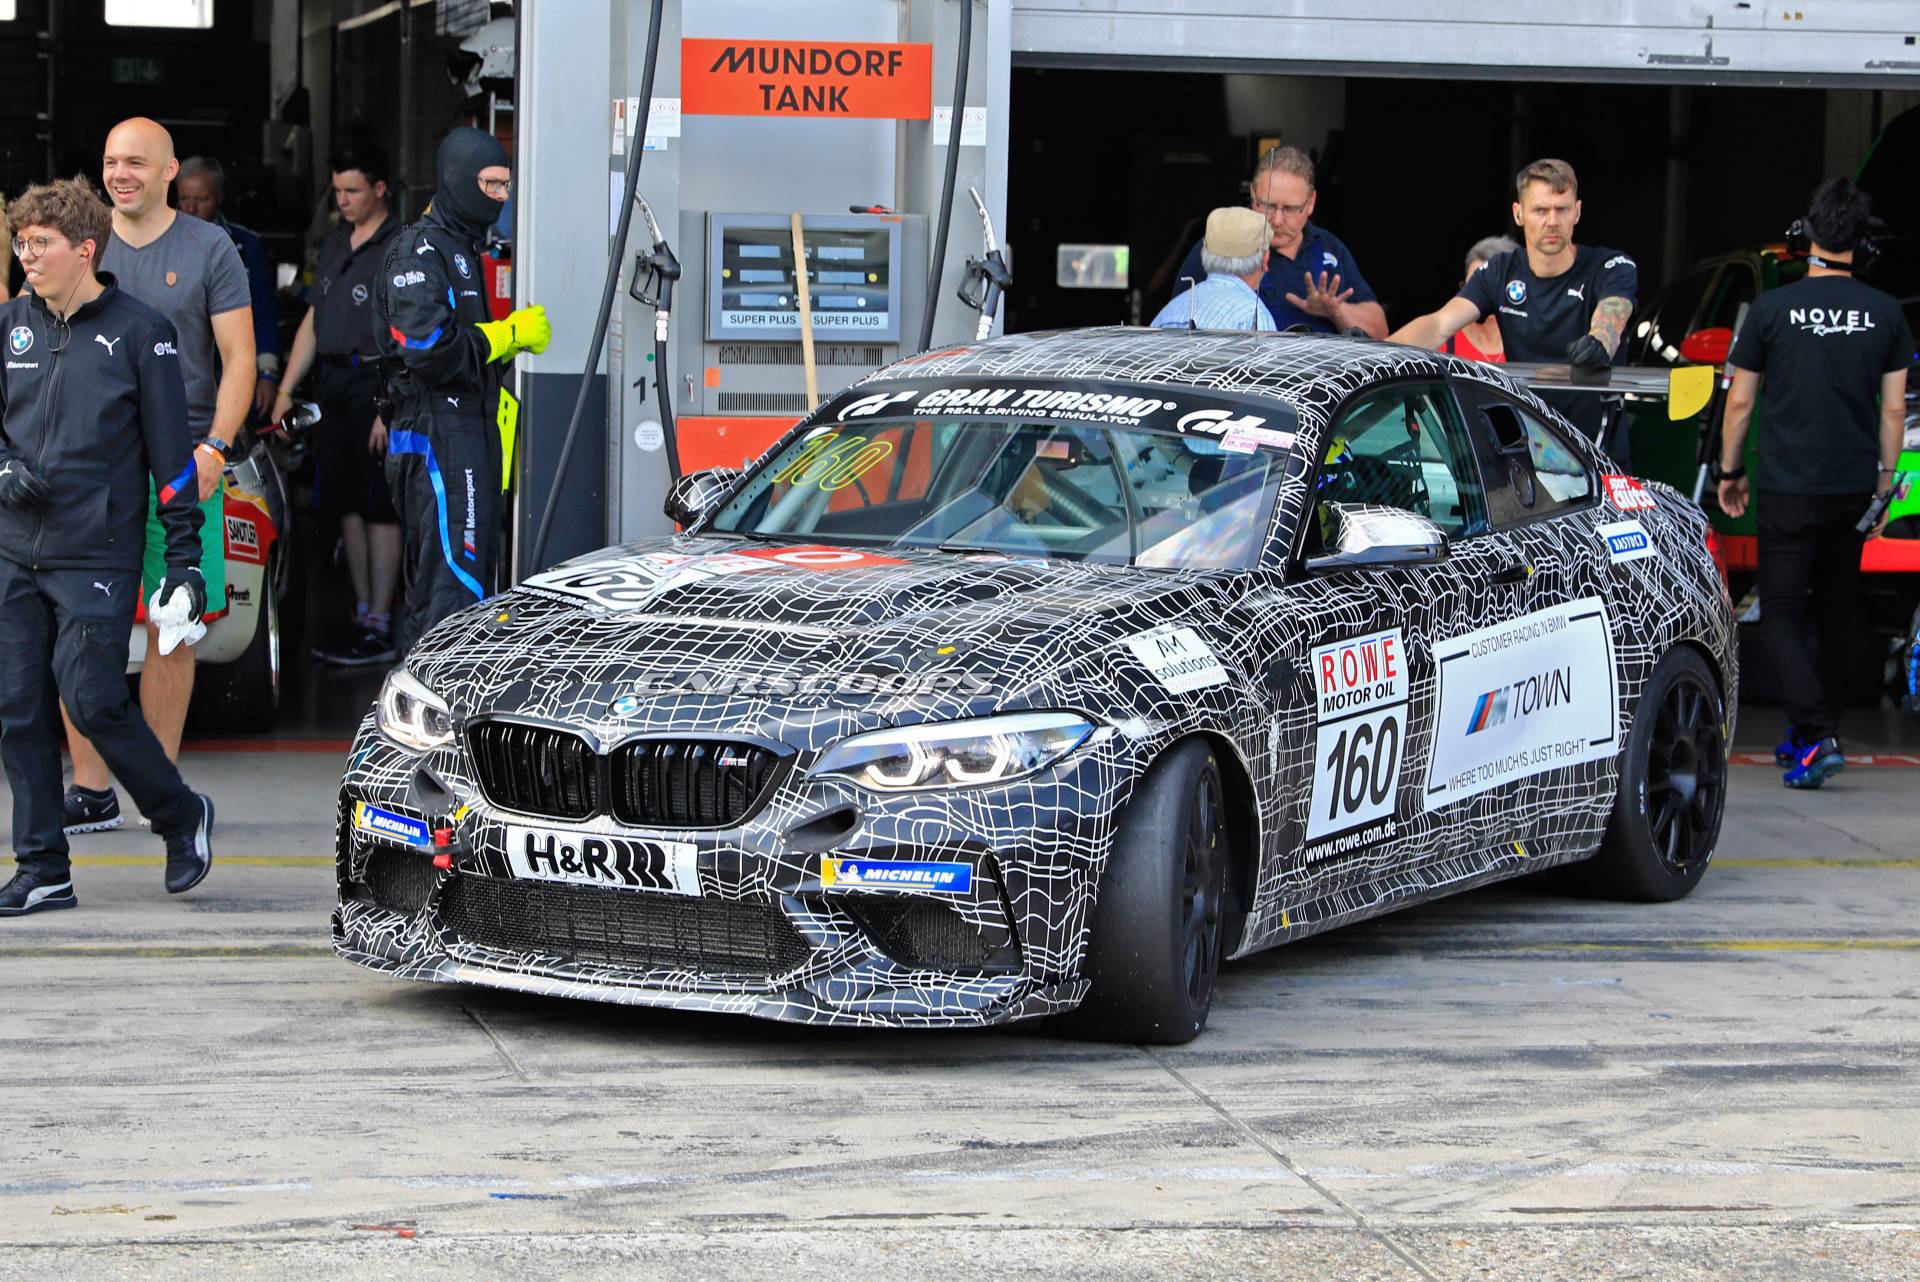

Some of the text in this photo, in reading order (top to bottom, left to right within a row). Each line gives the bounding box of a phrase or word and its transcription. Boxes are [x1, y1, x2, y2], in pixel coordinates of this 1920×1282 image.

[709, 46, 903, 77] MUNDORF
[759, 84, 849, 113] TANK
[730, 314, 797, 325] SUPER PLUS
[813, 315, 879, 326] SUPER PLUS
[1790, 307, 1875, 328] NOVEL
[1806, 323, 1861, 337] Racing
[917, 388, 1016, 408] GRAN
[943, 407, 981, 415] REAL
[983, 407, 1047, 418] DRIVING
[1050, 411, 1141, 426] SIMULATOR
[771, 432, 893, 491] 160
[464, 468, 476, 529] Motorsport
[1612, 487, 1656, 509] auto
[1471, 615, 1567, 658] CUSTOMER RACING IN BMW
[1155, 654, 1218, 680] solutions
[1319, 637, 1397, 695] ROWE
[1323, 680, 1396, 714] MOTOR OIL
[1513, 666, 1571, 719] TOWN
[1326, 715, 1398, 822] 160
[1449, 737, 1586, 793] WHERE TOO MUCH IS JUST RIGHT
[373, 815, 421, 837] MICHELIN
[1305, 817, 1397, 863] www.rowe.com.de
[864, 868, 955, 884] MICHELIN
